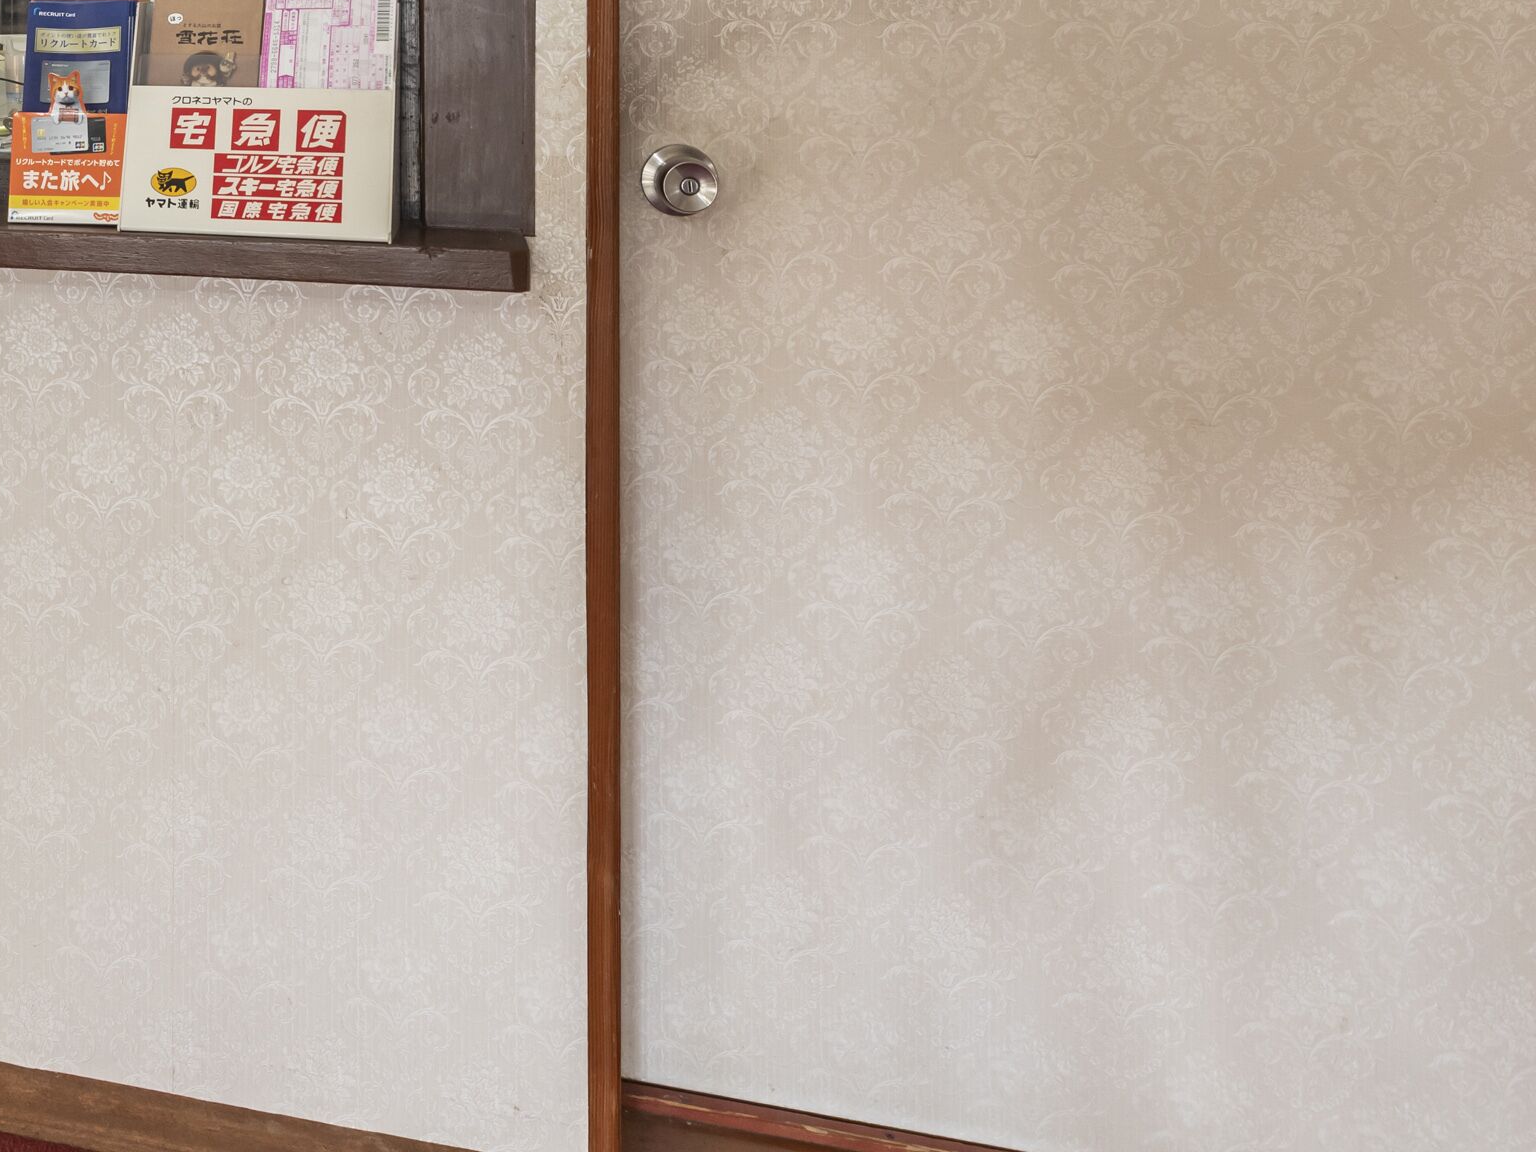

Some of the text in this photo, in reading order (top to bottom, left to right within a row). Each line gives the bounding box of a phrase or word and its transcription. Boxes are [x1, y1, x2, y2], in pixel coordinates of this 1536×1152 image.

[40, 38, 117, 49] リクルートカード
[171, 95, 253, 106] クロネコヤマトの
[174, 111, 343, 149] 宅急便
[217, 176, 340, 199] スキー宅急便
[145, 196, 200, 211] ヤマト運輸
[217, 199, 338, 222] 国際宅急便
